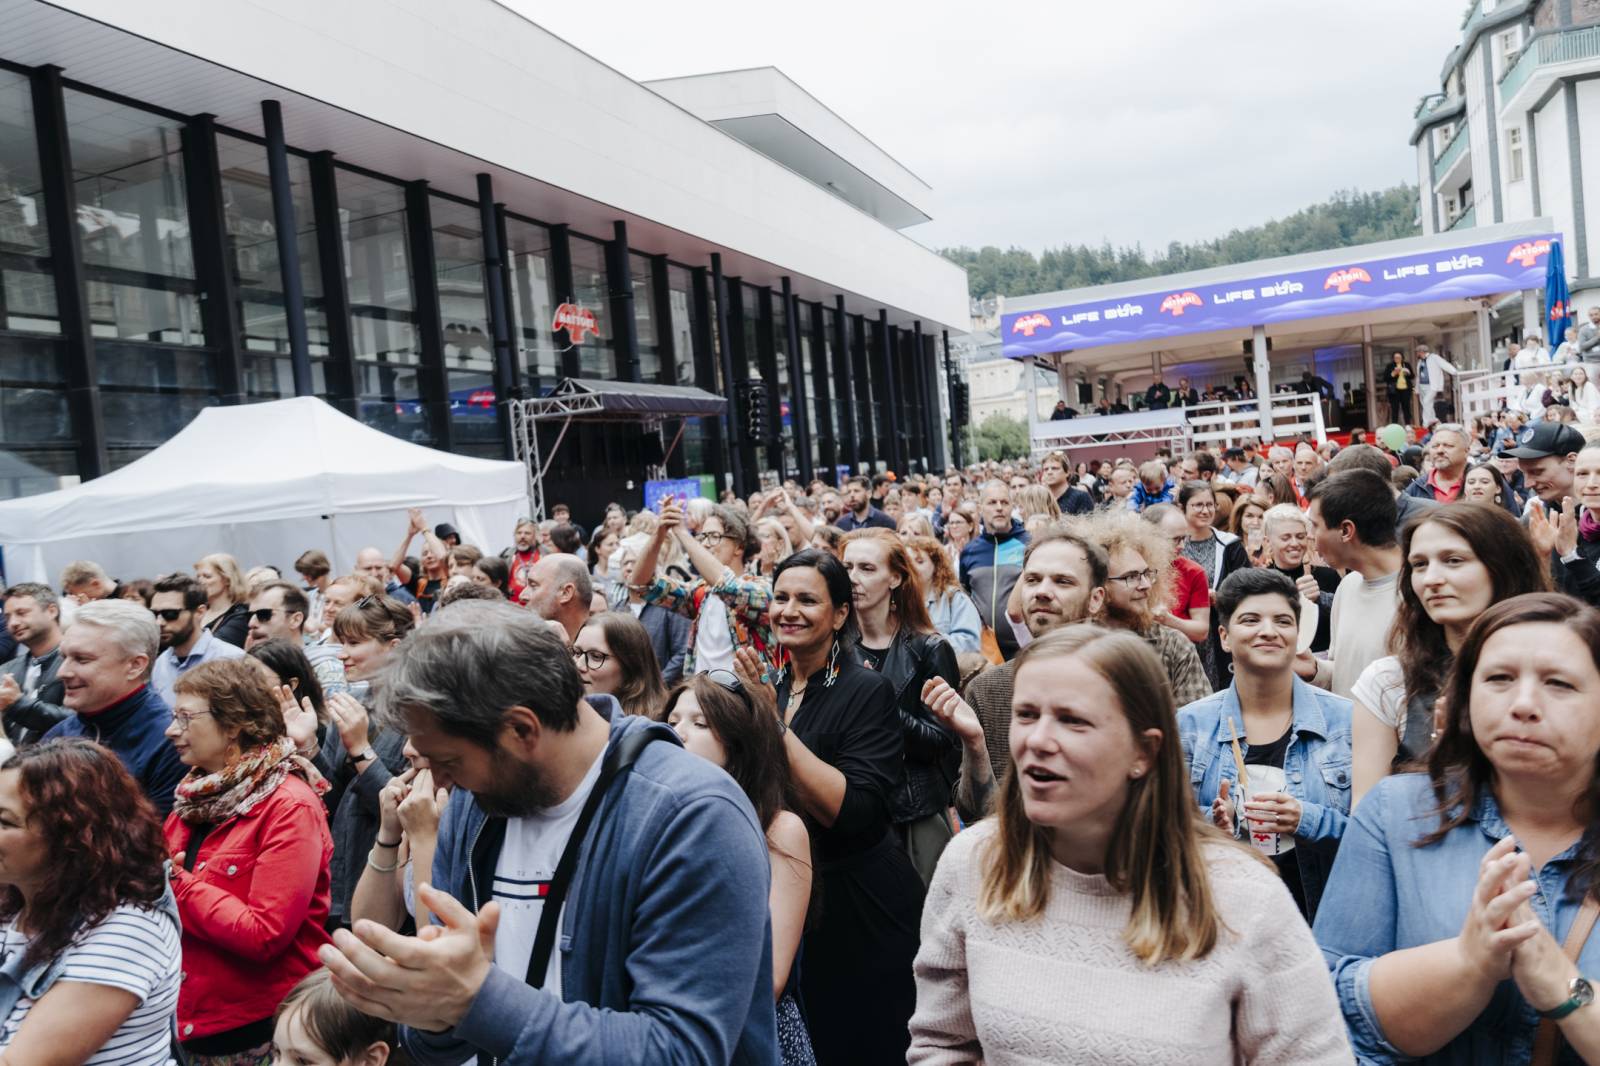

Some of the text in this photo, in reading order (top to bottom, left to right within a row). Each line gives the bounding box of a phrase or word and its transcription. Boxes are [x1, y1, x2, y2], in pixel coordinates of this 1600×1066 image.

[1384, 264, 1429, 280] LIFE
[1214, 289, 1255, 304] LIFE
[1062, 311, 1099, 325] LIFE
